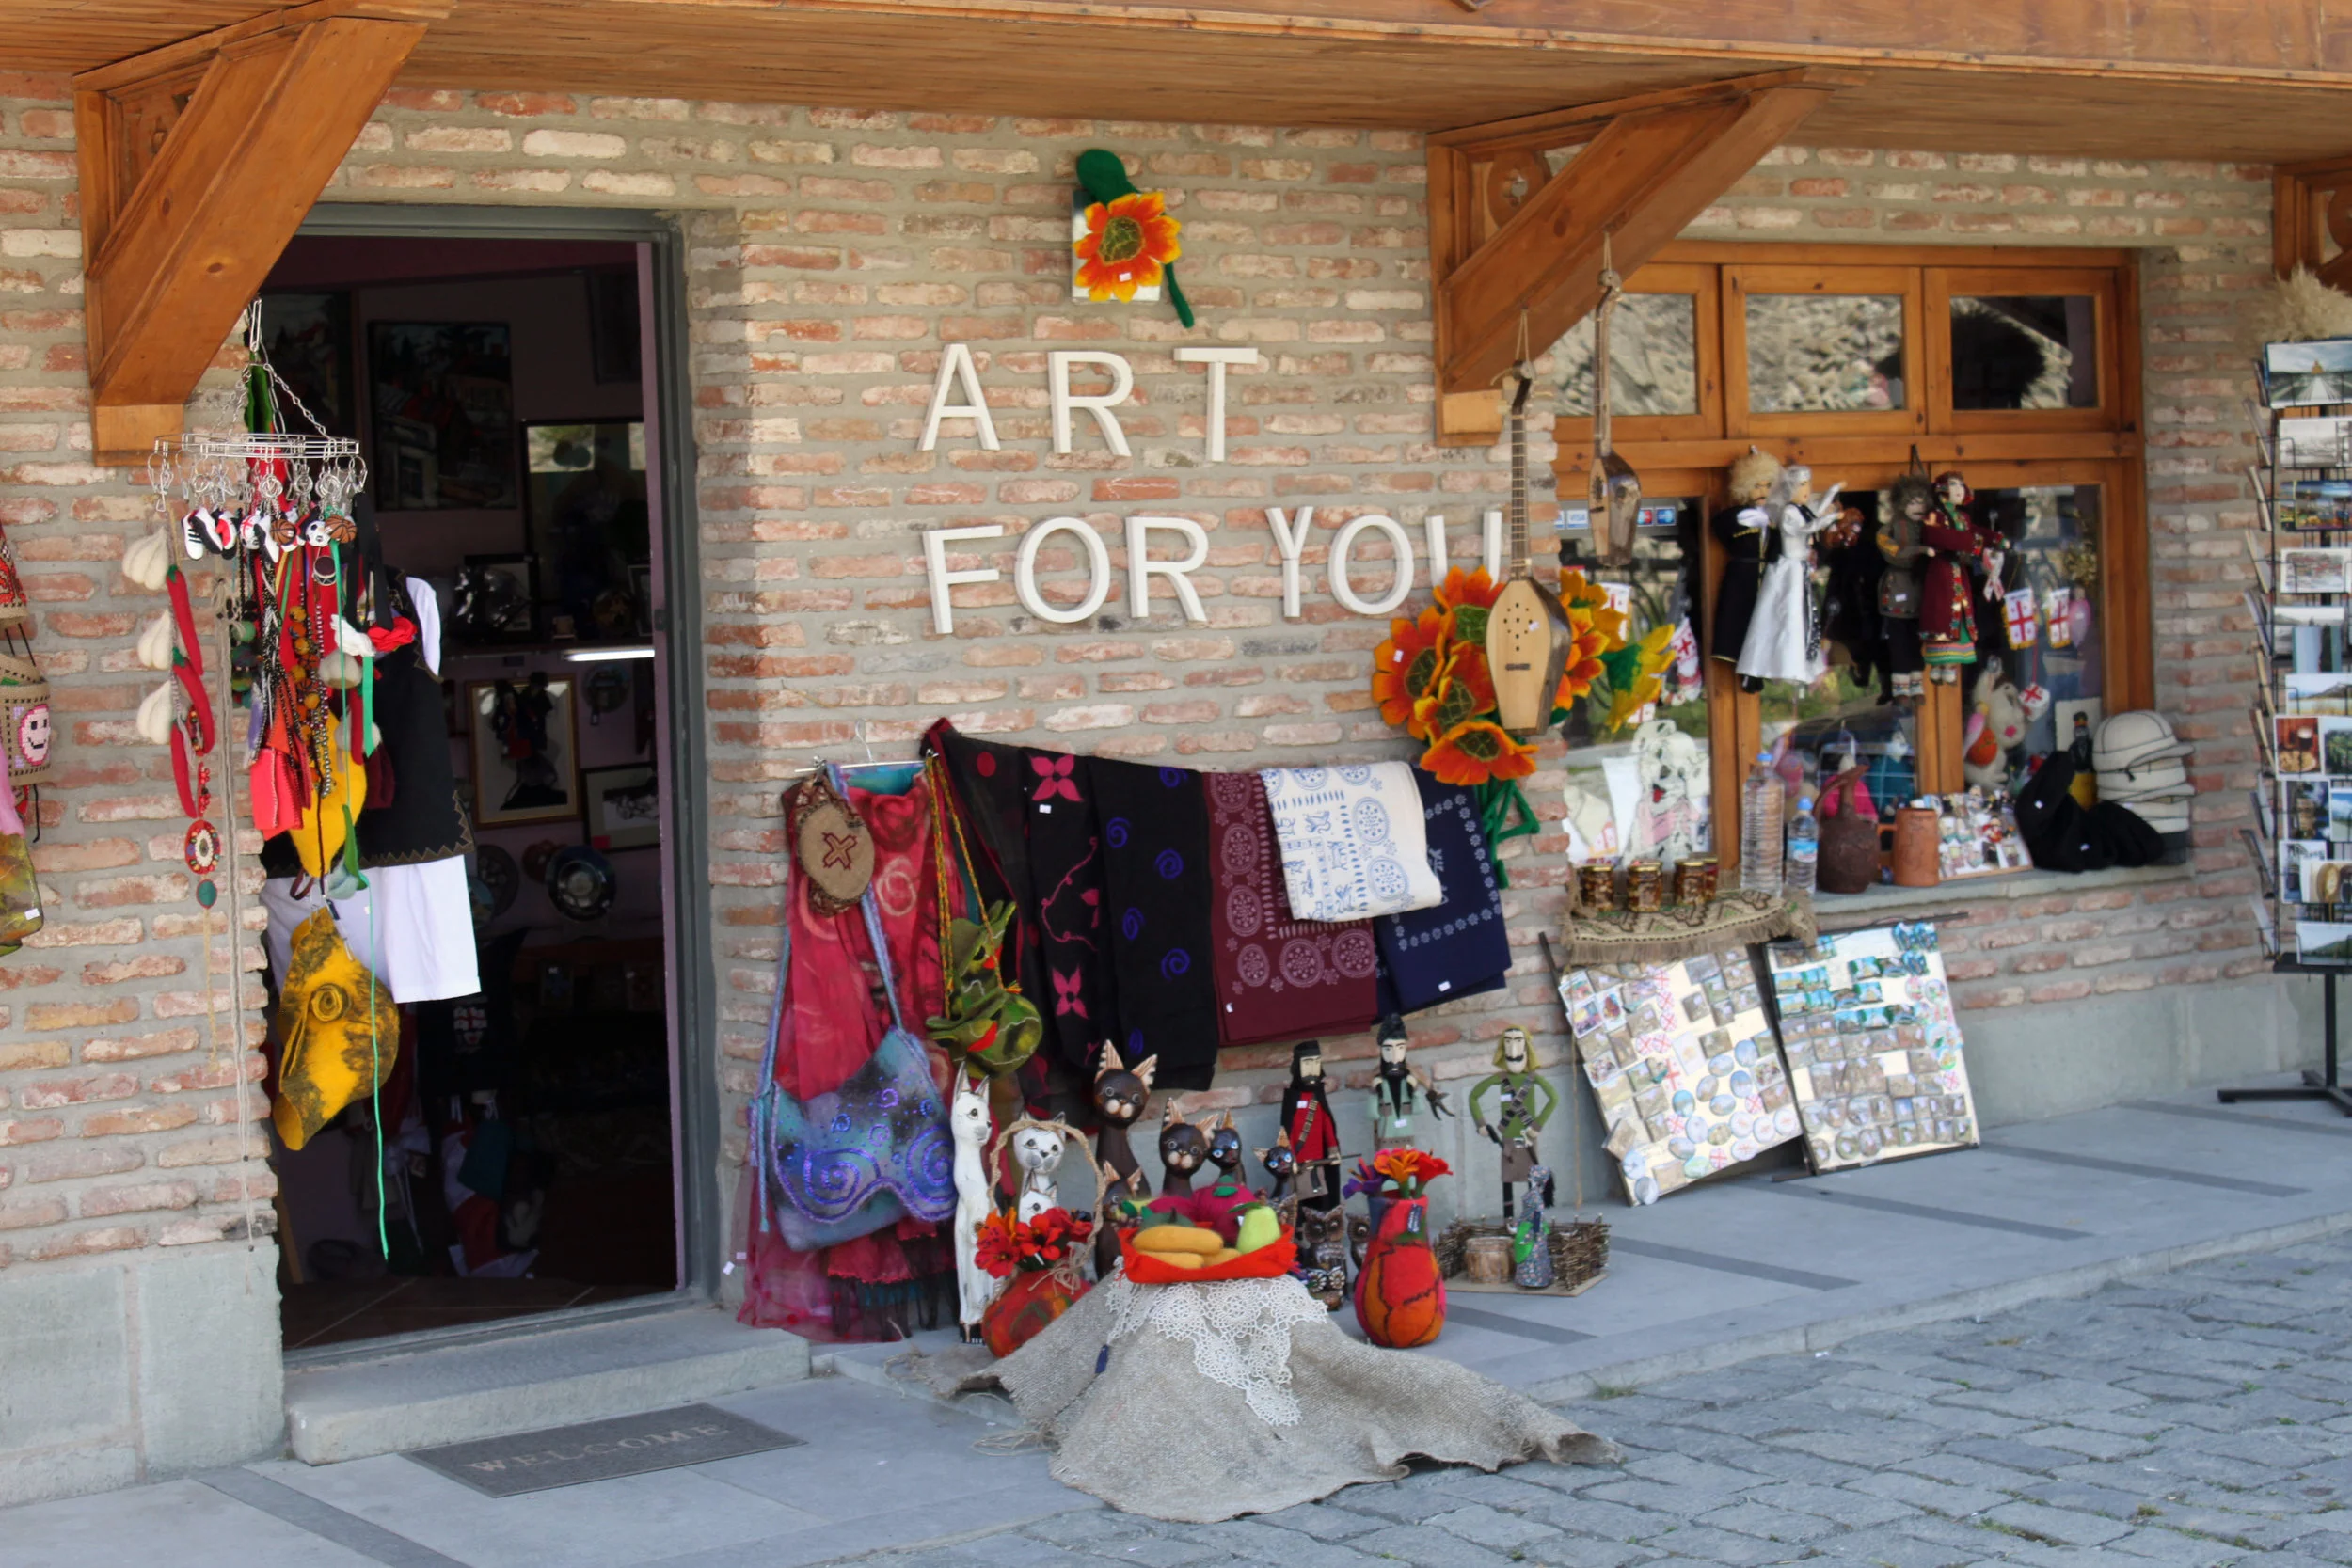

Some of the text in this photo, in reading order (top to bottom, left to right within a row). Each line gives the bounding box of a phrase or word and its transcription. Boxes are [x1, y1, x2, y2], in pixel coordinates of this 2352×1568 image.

[917, 343, 1258, 462] ART
[923, 516, 1209, 634] FOR
[465, 1424, 730, 1471] WELCOME
